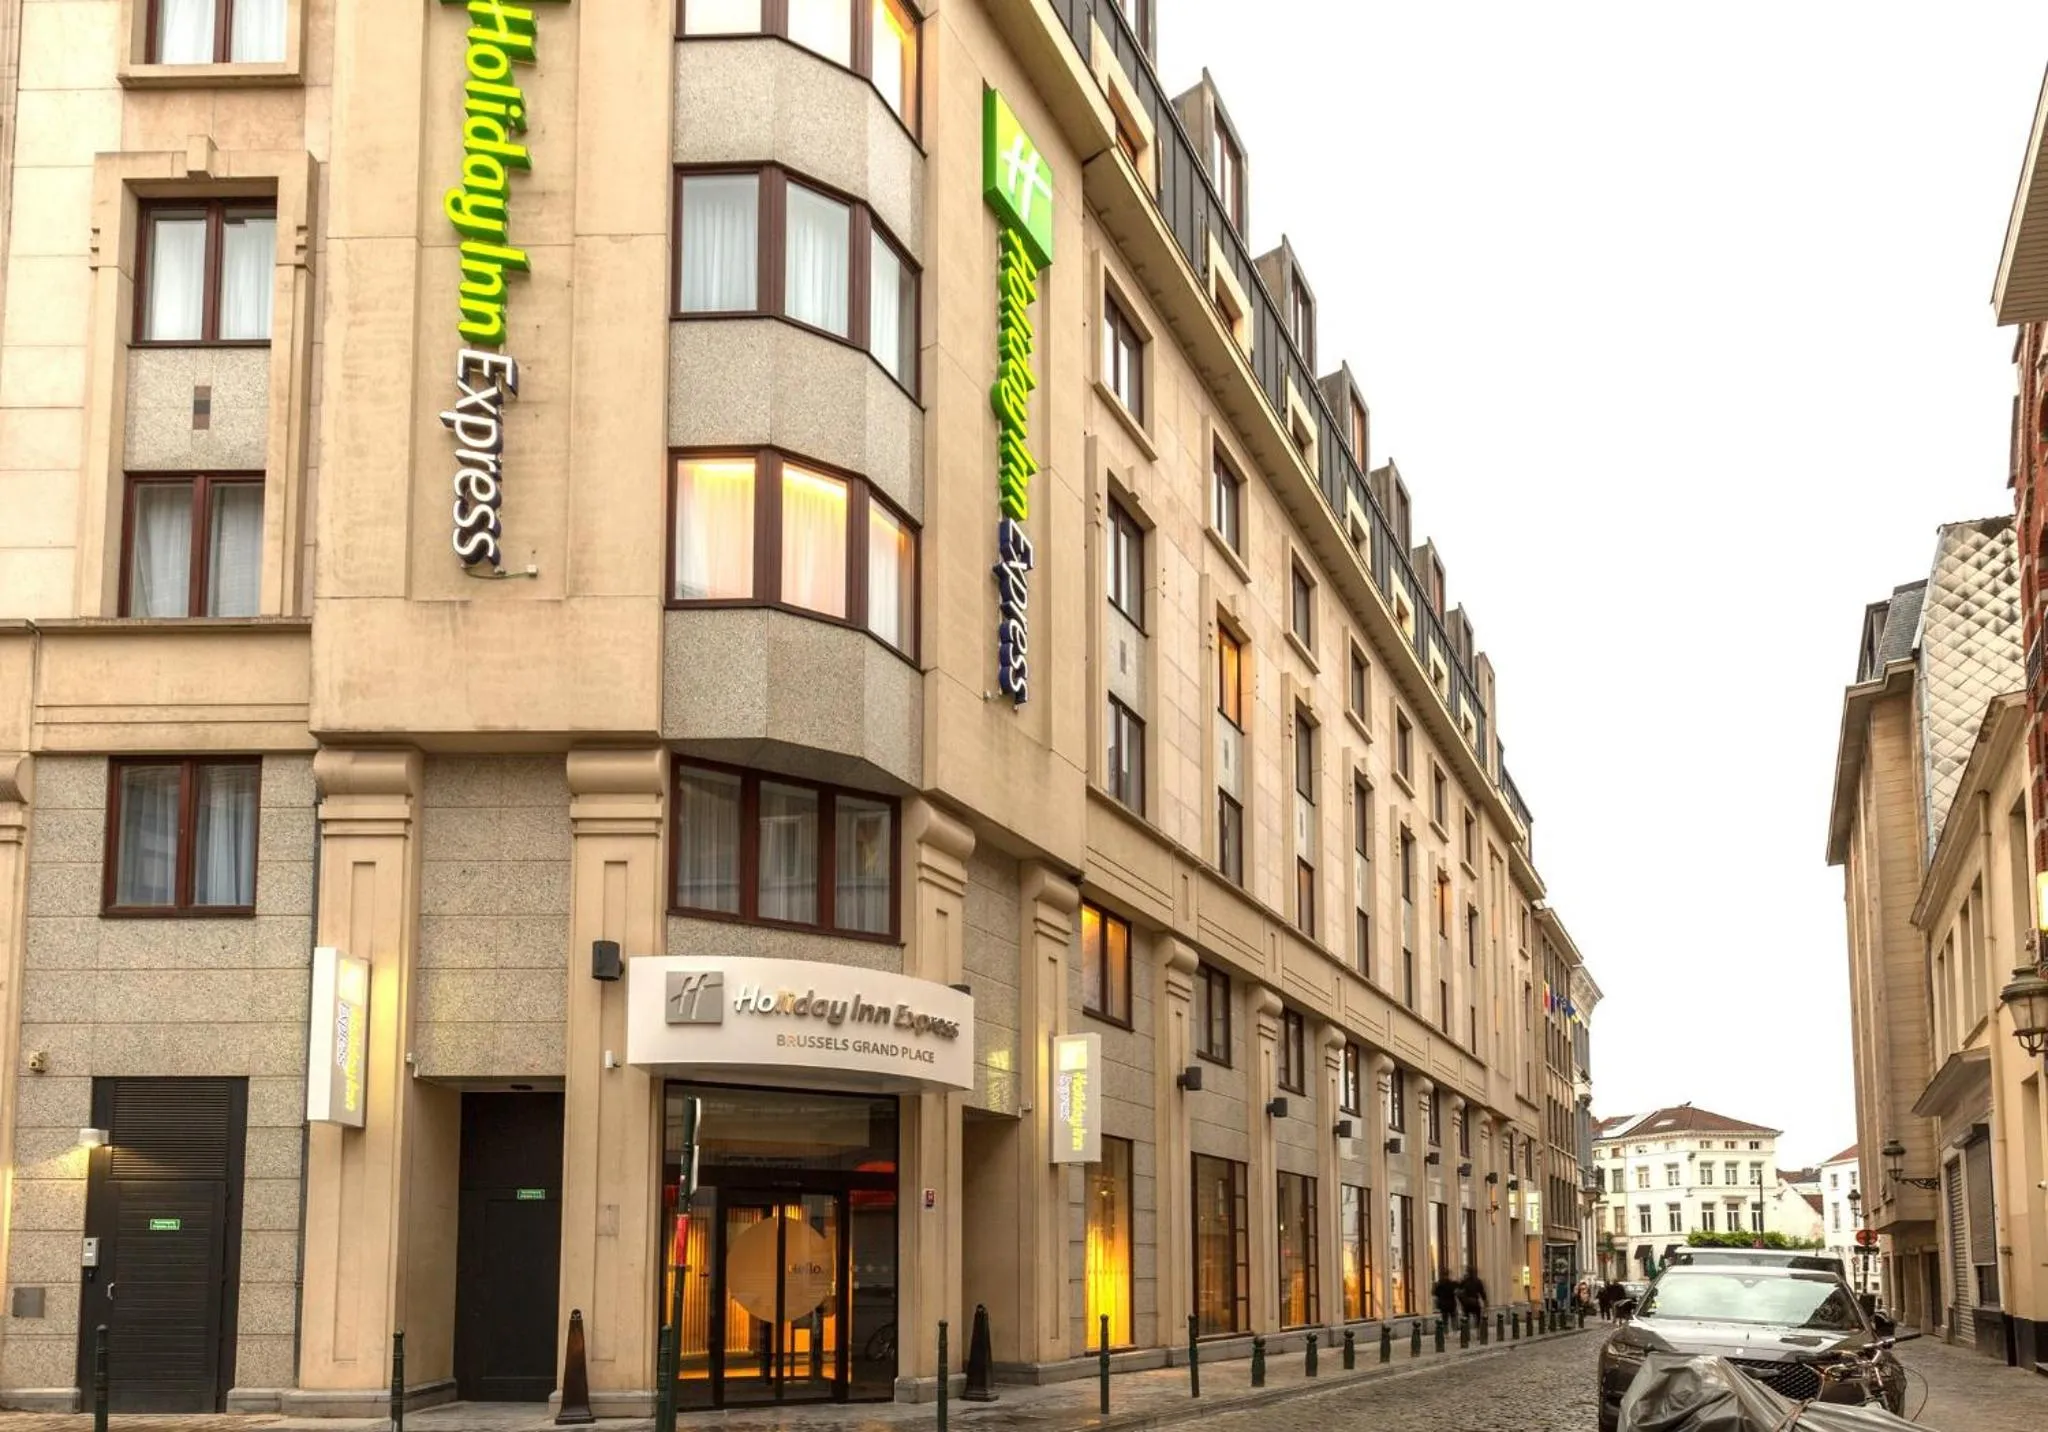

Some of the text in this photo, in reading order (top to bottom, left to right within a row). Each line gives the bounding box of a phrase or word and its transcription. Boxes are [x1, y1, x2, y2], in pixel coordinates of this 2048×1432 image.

[440, 0, 537, 568] Holiday Inn Express
[990, 227, 1039, 707] Holiday Inn Express
[734, 983, 961, 1041] Holiday Inn Express
[776, 1033, 935, 1064] BRUSSELS GRAND PLACE
